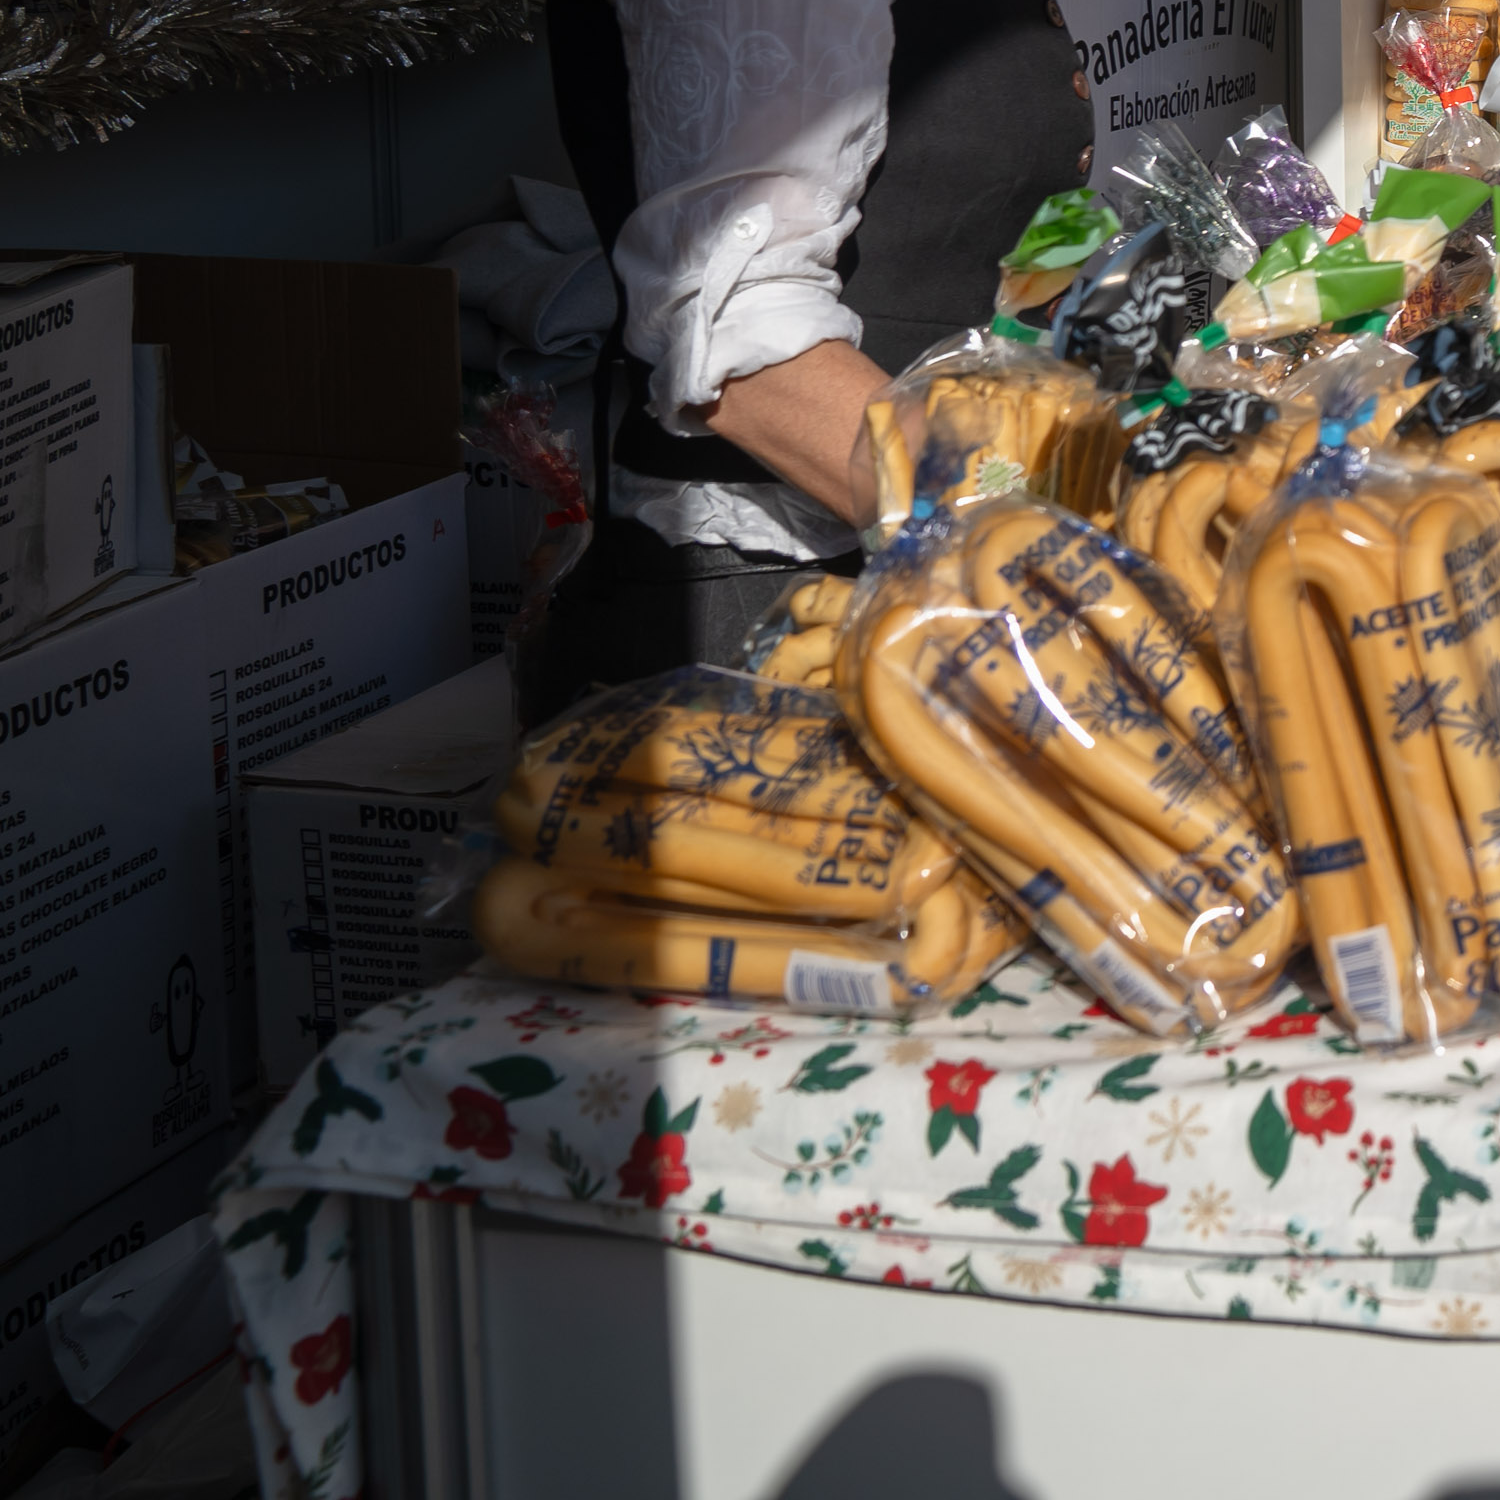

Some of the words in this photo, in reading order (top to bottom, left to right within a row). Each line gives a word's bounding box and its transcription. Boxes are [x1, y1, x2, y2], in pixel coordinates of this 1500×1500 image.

[1110, 80, 1199, 131] Elaboración
[1204, 69, 1257, 110] Artesana
[0, 299, 74, 352] ODUCTOS
[263, 533, 407, 614] PRODUCTOS
[1350, 590, 1450, 639] ACEITE
[235, 638, 314, 681] ROSQUILLAS
[236, 657, 326, 703] ROSQUILLITAS
[237, 685, 316, 727] ROSQUILLAS
[319, 676, 333, 690] 24
[237, 707, 317, 750] ROSQUILLAS
[320, 674, 388, 713] MATALAUVA
[238, 728, 318, 773] ROSQUILLAS
[320, 694, 392, 737] INTEGRALES
[17, 832, 36, 850] 24
[17, 824, 107, 882] MATALAUVA
[329, 833, 411, 850] ROSQUILLAS
[331, 851, 424, 868] ROSQUILLITAS
[19, 846, 112, 906] INTEGRALES
[20, 869, 109, 933] CHOCOLATE
[111, 847, 159, 889] NEGRO
[332, 868, 414, 885] ROSQUILLAS
[334, 886, 416, 902] ROSQUILLAS
[21, 891, 110, 955] CHOCOLATE
[112, 866, 168, 909] BLANCO
[337, 921, 419, 938] ROSQUILLAS
[337, 938, 420, 955] ROSQUILLAS
[339, 955, 394, 971] PALITOS
[341, 973, 395, 987] PALITOS
[153, 1083, 212, 1131] ROSQUILLAS
[153, 1124, 169, 1149] DE
[173, 1104, 212, 1141] ALHAMA
